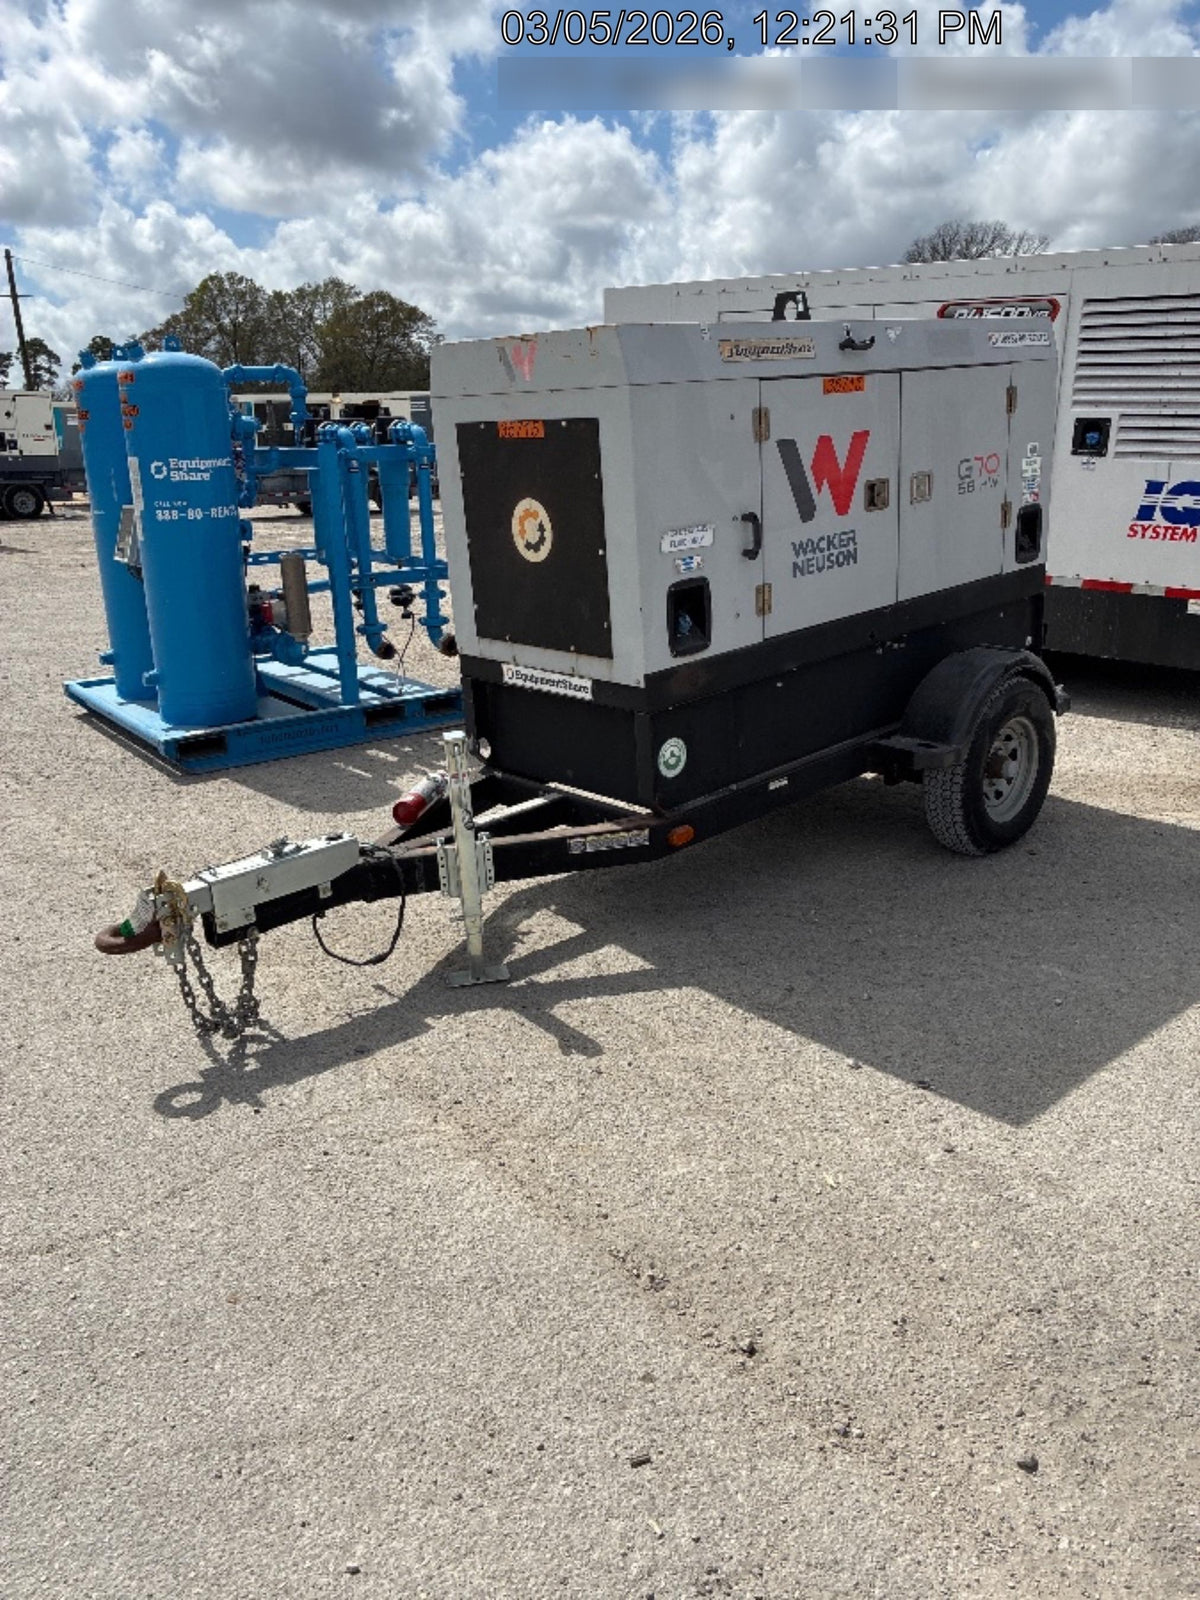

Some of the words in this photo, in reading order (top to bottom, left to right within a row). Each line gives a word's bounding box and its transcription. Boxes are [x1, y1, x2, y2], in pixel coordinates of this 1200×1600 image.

[169, 471, 212, 482] Share
[776, 430, 870, 523] W
[791, 530, 858, 559] WACKER
[1126, 523, 1198, 542] SYSTEM
[792, 547, 858, 578] NEUSON
[514, 669, 590, 694] EquipmentShare
